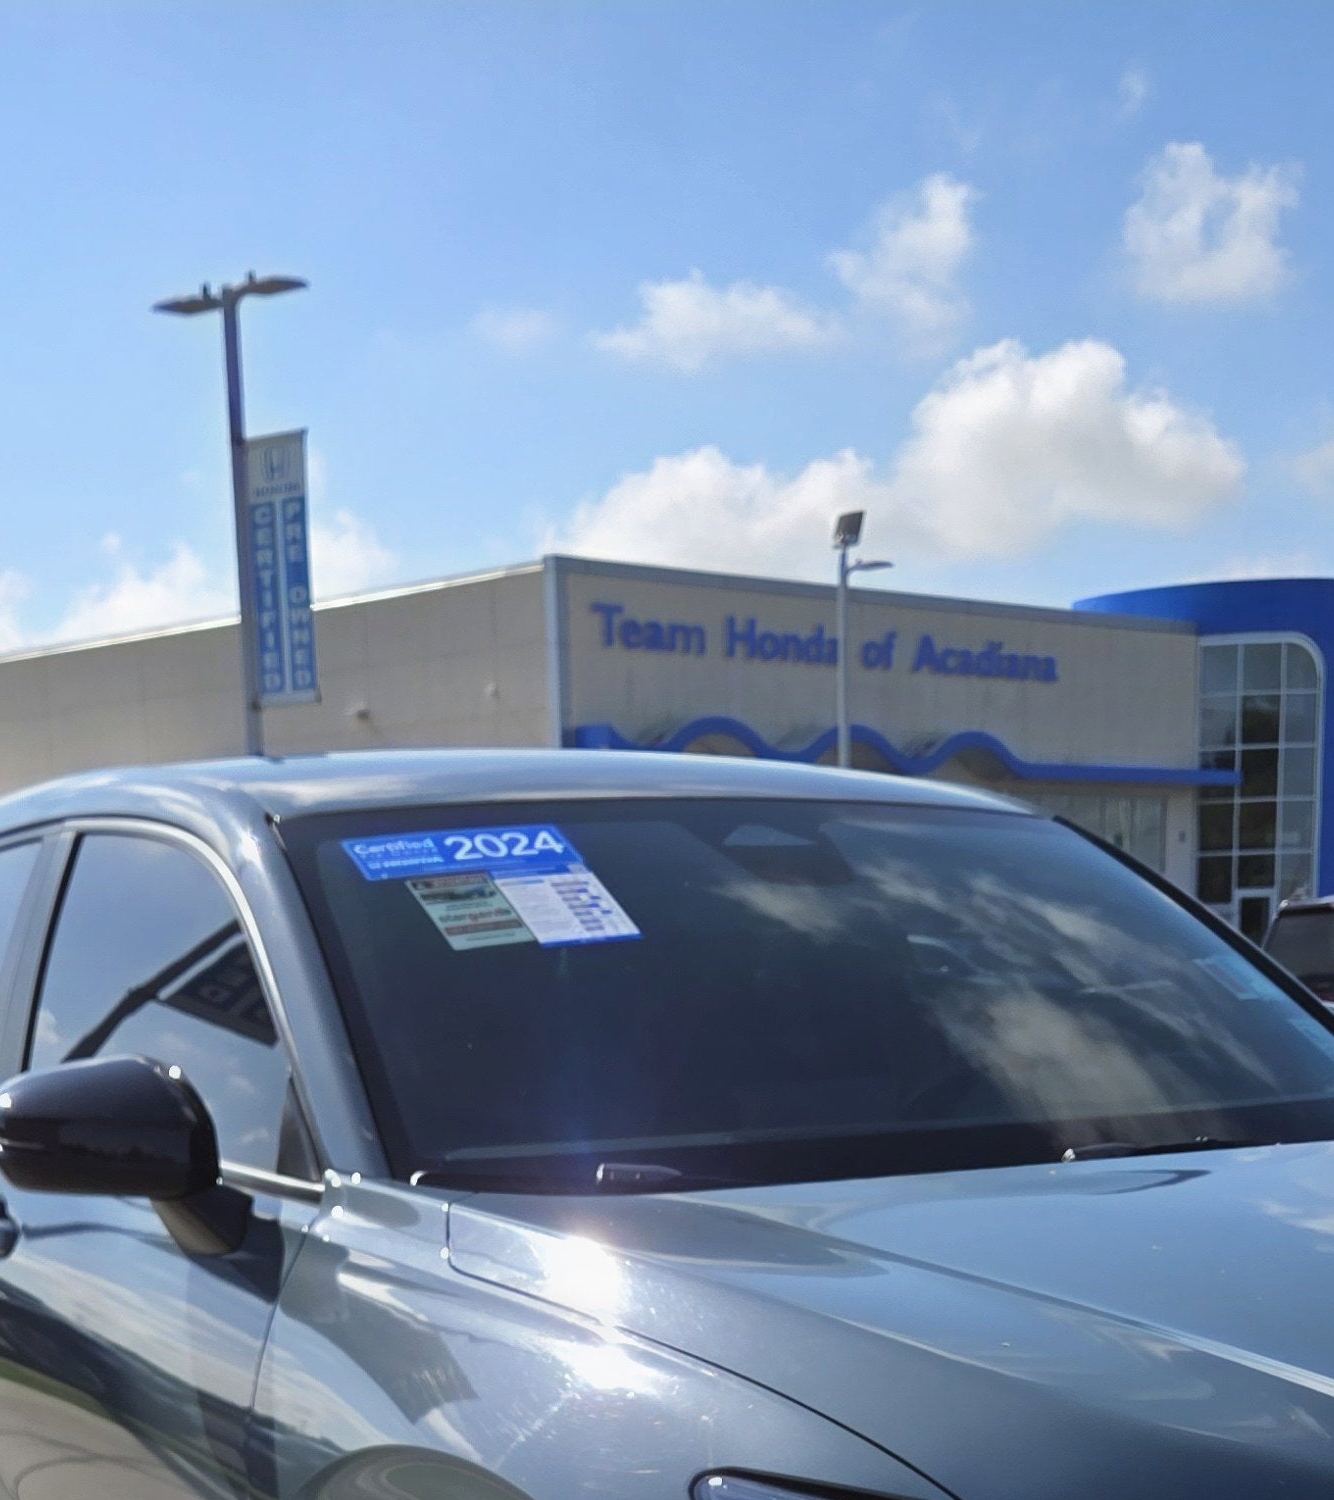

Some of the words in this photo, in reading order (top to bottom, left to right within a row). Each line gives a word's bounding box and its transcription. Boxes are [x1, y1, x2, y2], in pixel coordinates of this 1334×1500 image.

[590, 601, 706, 656] Team
[860, 629, 898, 671] of
[912, 633, 1059, 684] Acadiana
[444, 830, 565, 861] 2024
